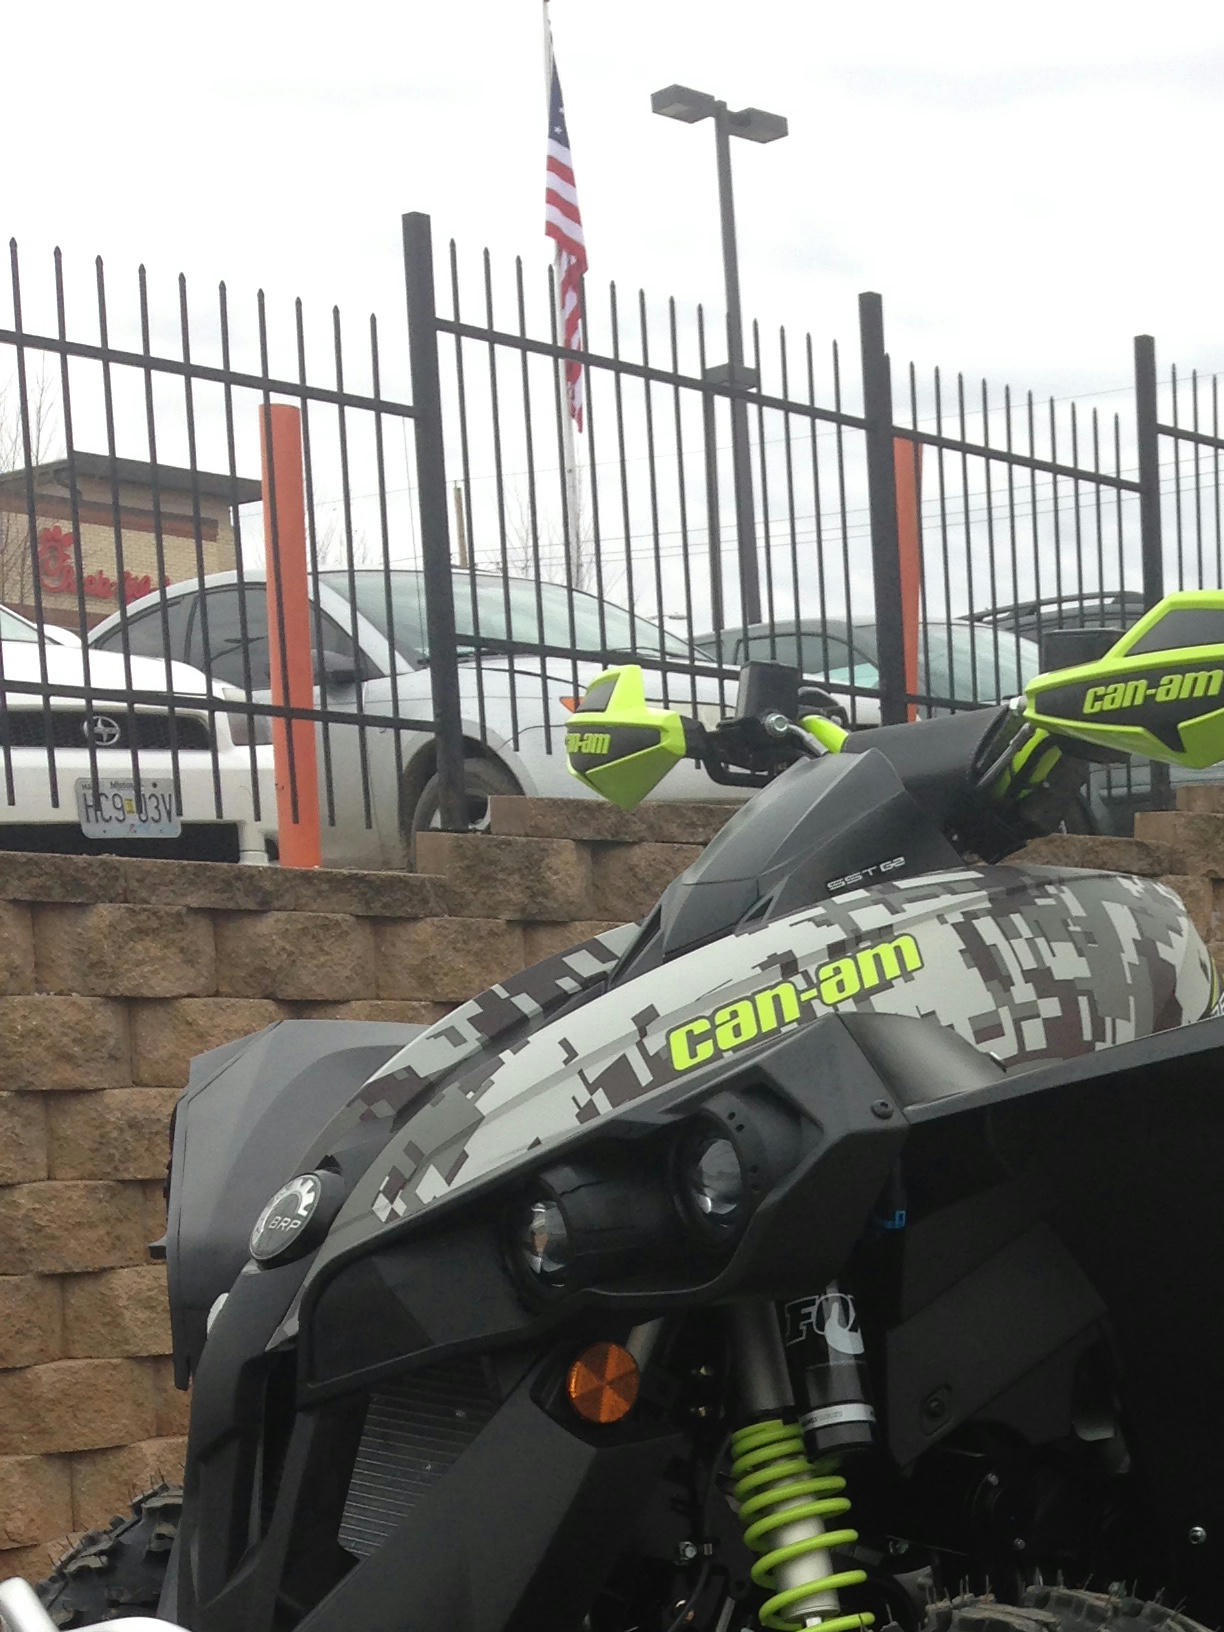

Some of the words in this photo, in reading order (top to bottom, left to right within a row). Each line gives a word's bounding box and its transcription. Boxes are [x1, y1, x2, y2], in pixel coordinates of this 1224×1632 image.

[1082, 669, 1224, 714] can-am
[827, 866, 877, 891] SST
[669, 934, 924, 1071] can-am
[269, 1216, 302, 1231] BRP
